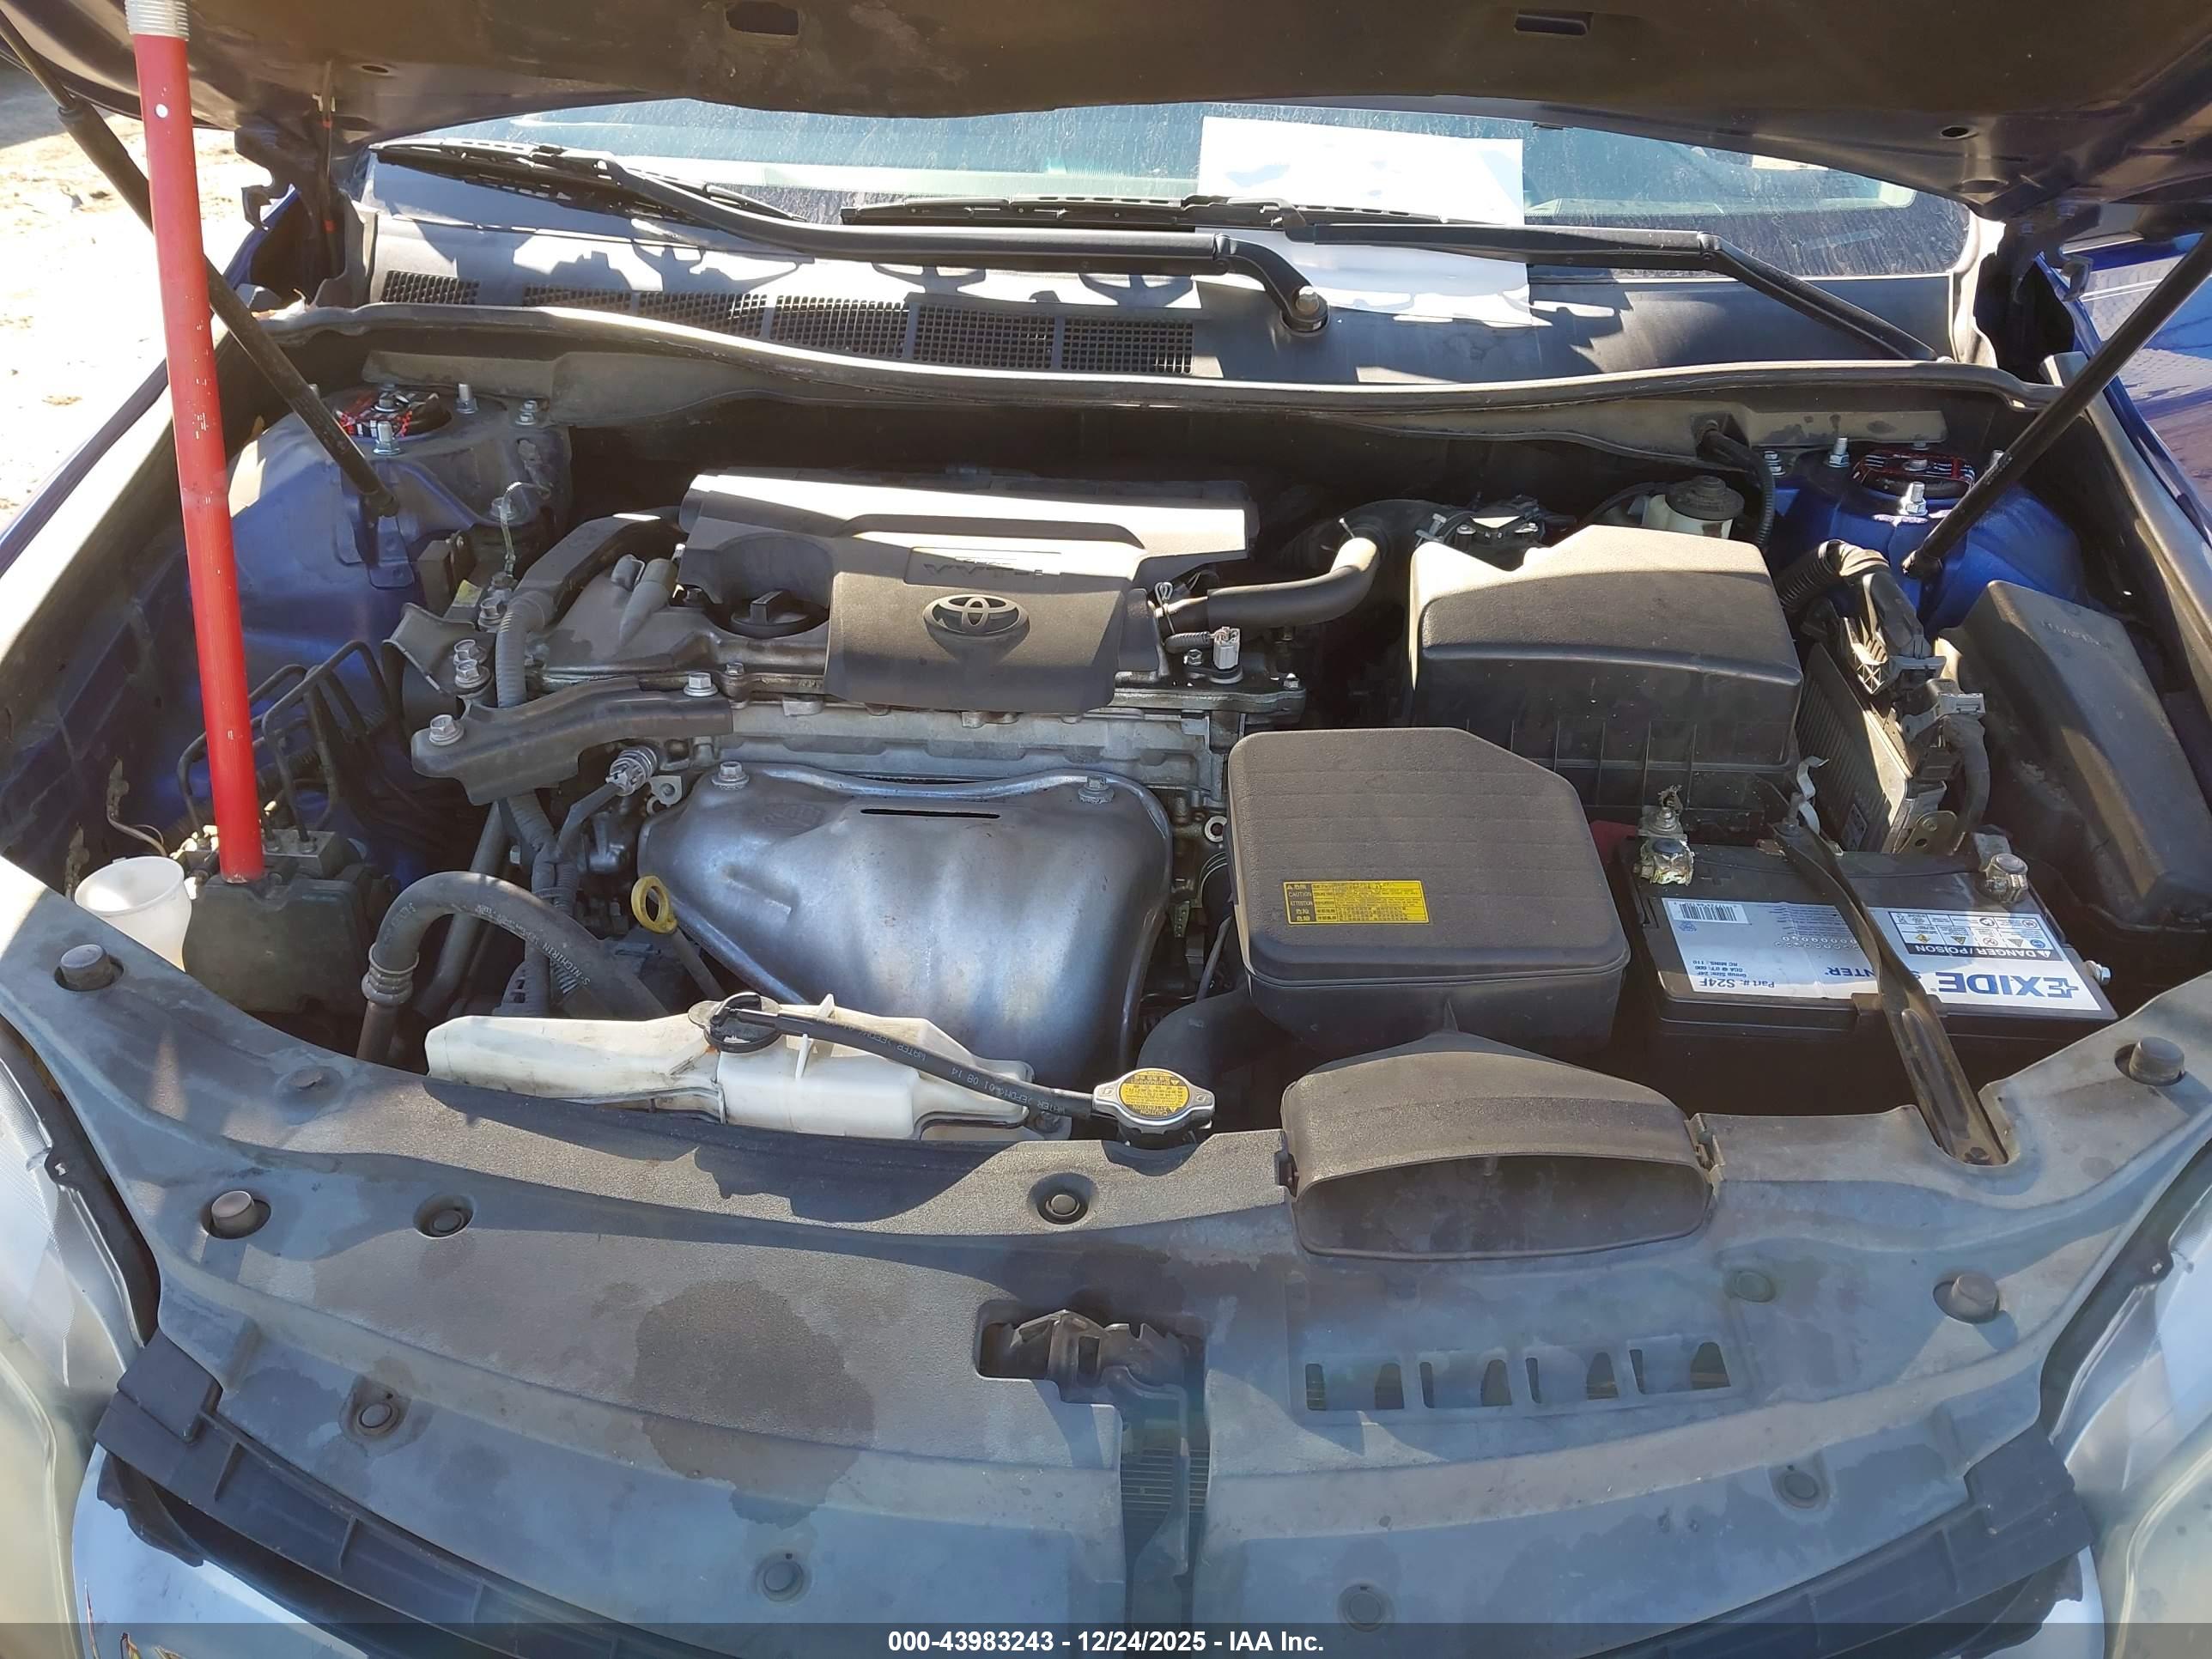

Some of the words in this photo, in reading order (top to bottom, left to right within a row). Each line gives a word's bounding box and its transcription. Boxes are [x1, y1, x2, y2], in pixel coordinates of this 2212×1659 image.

[1915, 945, 1967, 955] POISON
[1976, 947, 2037, 957] DANGER
[1698, 978, 1735, 988] S24F
[1753, 980, 1775, 988] Part
[1935, 971, 2079, 999] EXIDE
[896, 1042, 927, 1061] WATER
[951, 1066, 963, 1079] 14
[967, 1073, 979, 1086] 08
[1036, 1100, 1066, 1114] WATER
